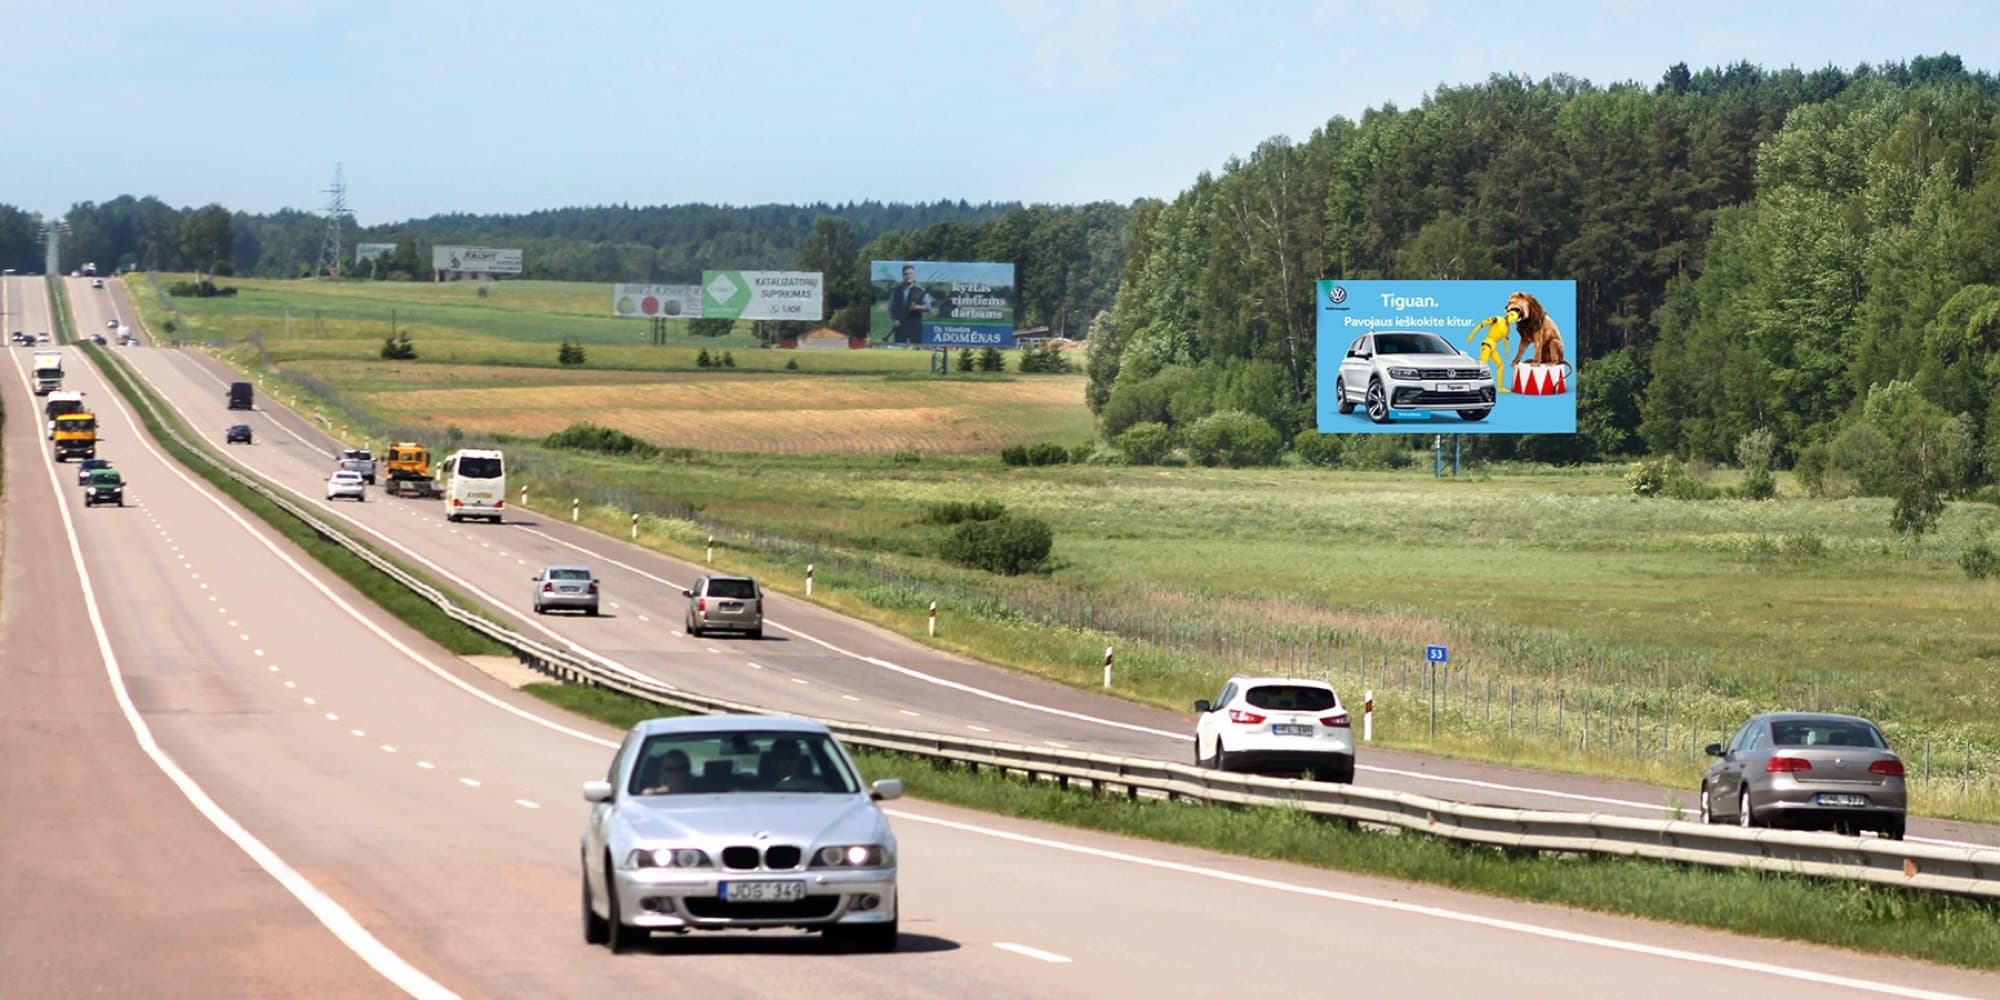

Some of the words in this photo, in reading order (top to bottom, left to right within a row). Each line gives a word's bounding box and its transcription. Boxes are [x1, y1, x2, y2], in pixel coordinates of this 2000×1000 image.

[1381, 293, 1439, 311] Tiguan.
[1344, 317, 1393, 329] Pavojaus
[1395, 316, 1445, 327] ieškokite
[1446, 316, 1476, 327] kitur.
[1430, 649, 1443, 660] 53
